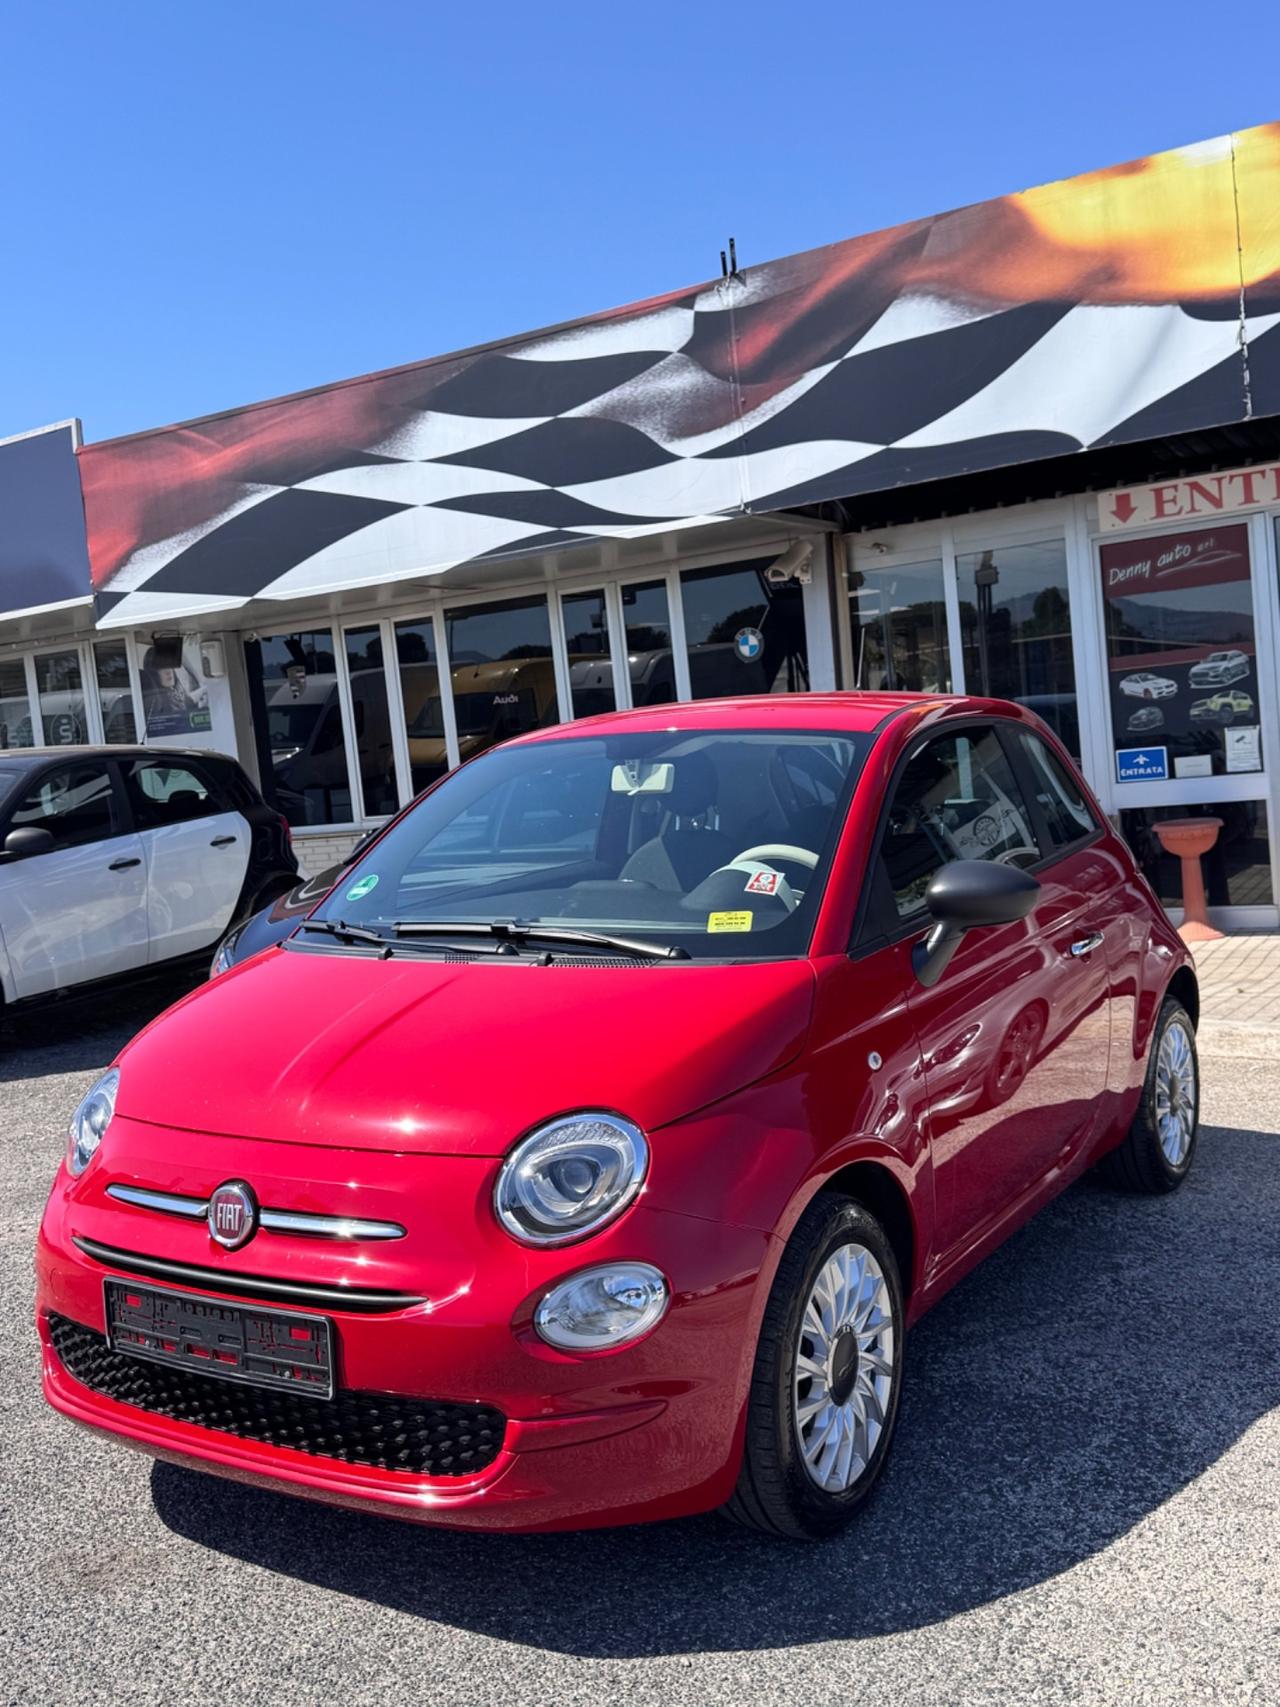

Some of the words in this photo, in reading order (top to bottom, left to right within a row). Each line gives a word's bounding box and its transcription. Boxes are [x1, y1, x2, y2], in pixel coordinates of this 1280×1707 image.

[1108, 560, 1152, 585] Denny
[1157, 543, 1192, 567] auto
[492, 693, 519, 705] Audi
[1120, 766, 1164, 778] ENTRATA
[217, 1203, 242, 1231] FIAT
